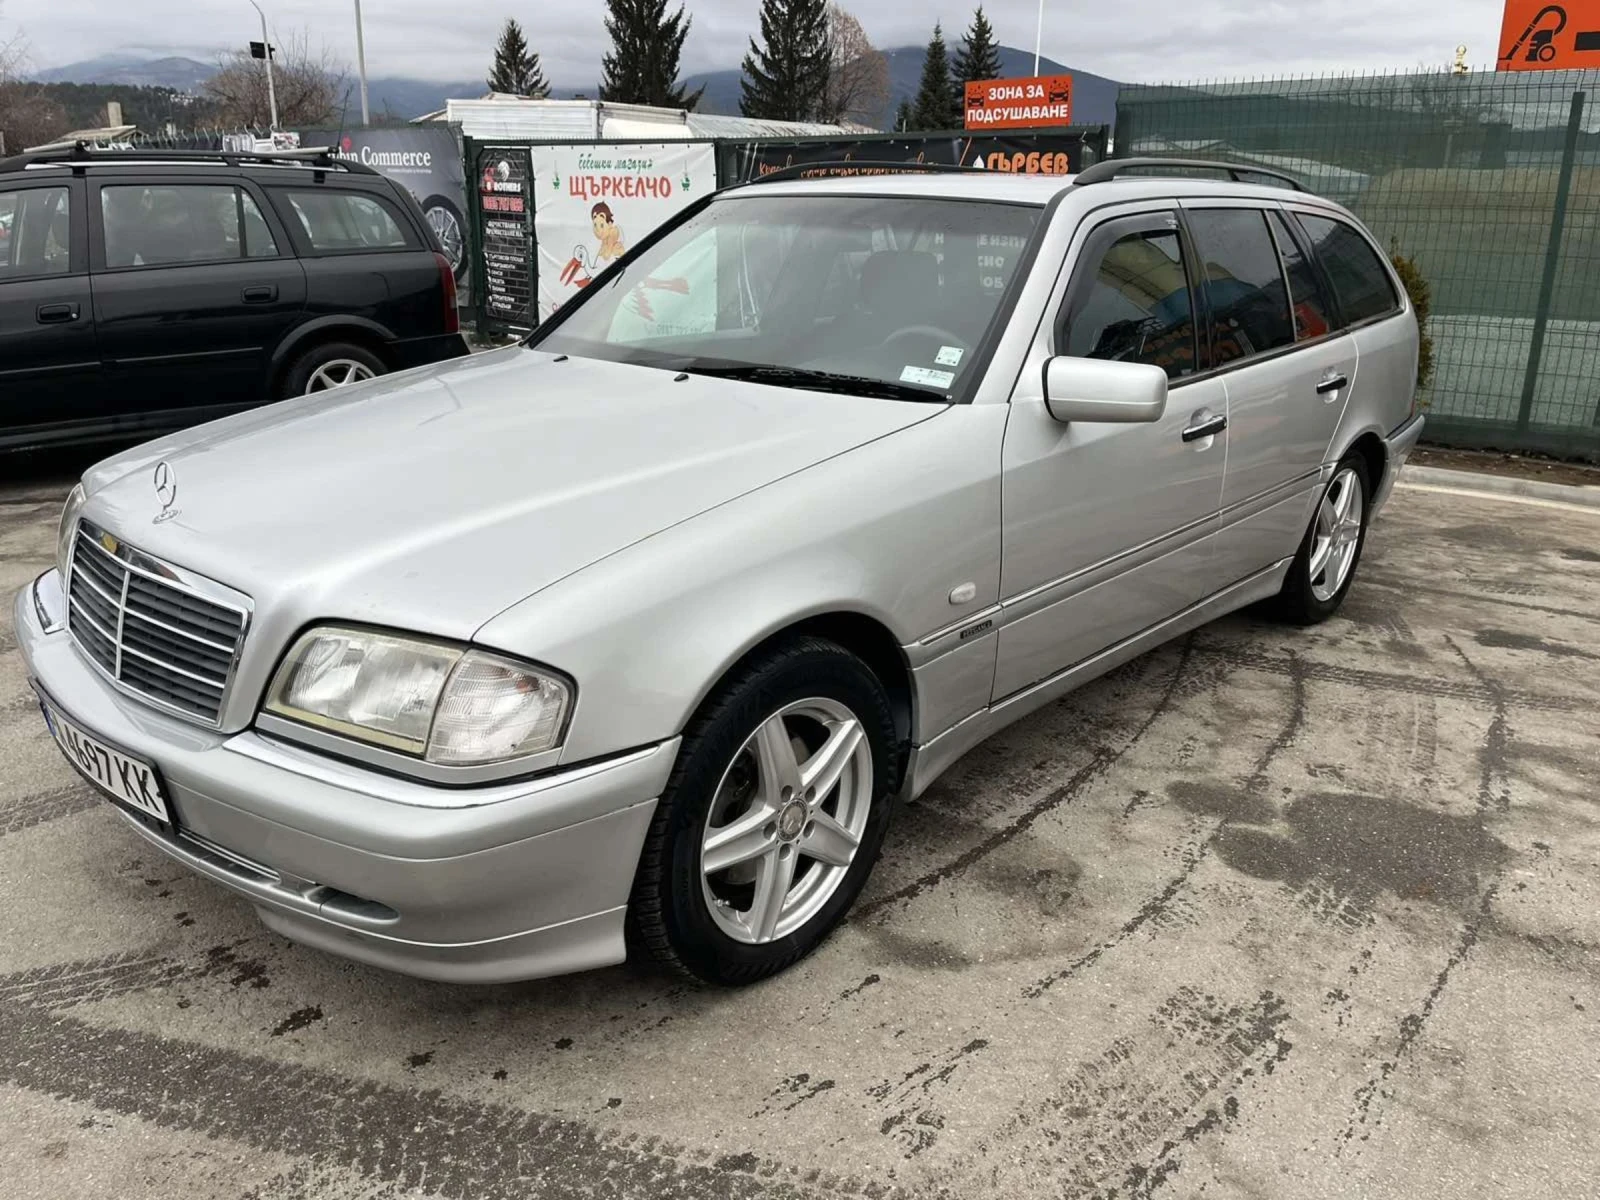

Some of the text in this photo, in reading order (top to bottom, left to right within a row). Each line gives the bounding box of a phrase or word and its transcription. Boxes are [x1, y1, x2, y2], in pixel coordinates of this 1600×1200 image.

[988, 85, 1045, 101] ЗОНА ЗА
[967, 104, 1069, 124] ПОДСУШАВАНЕ
[361, 146, 432, 166] Commerce
[569, 175, 672, 200] ЩЪРКЕЛЧО
